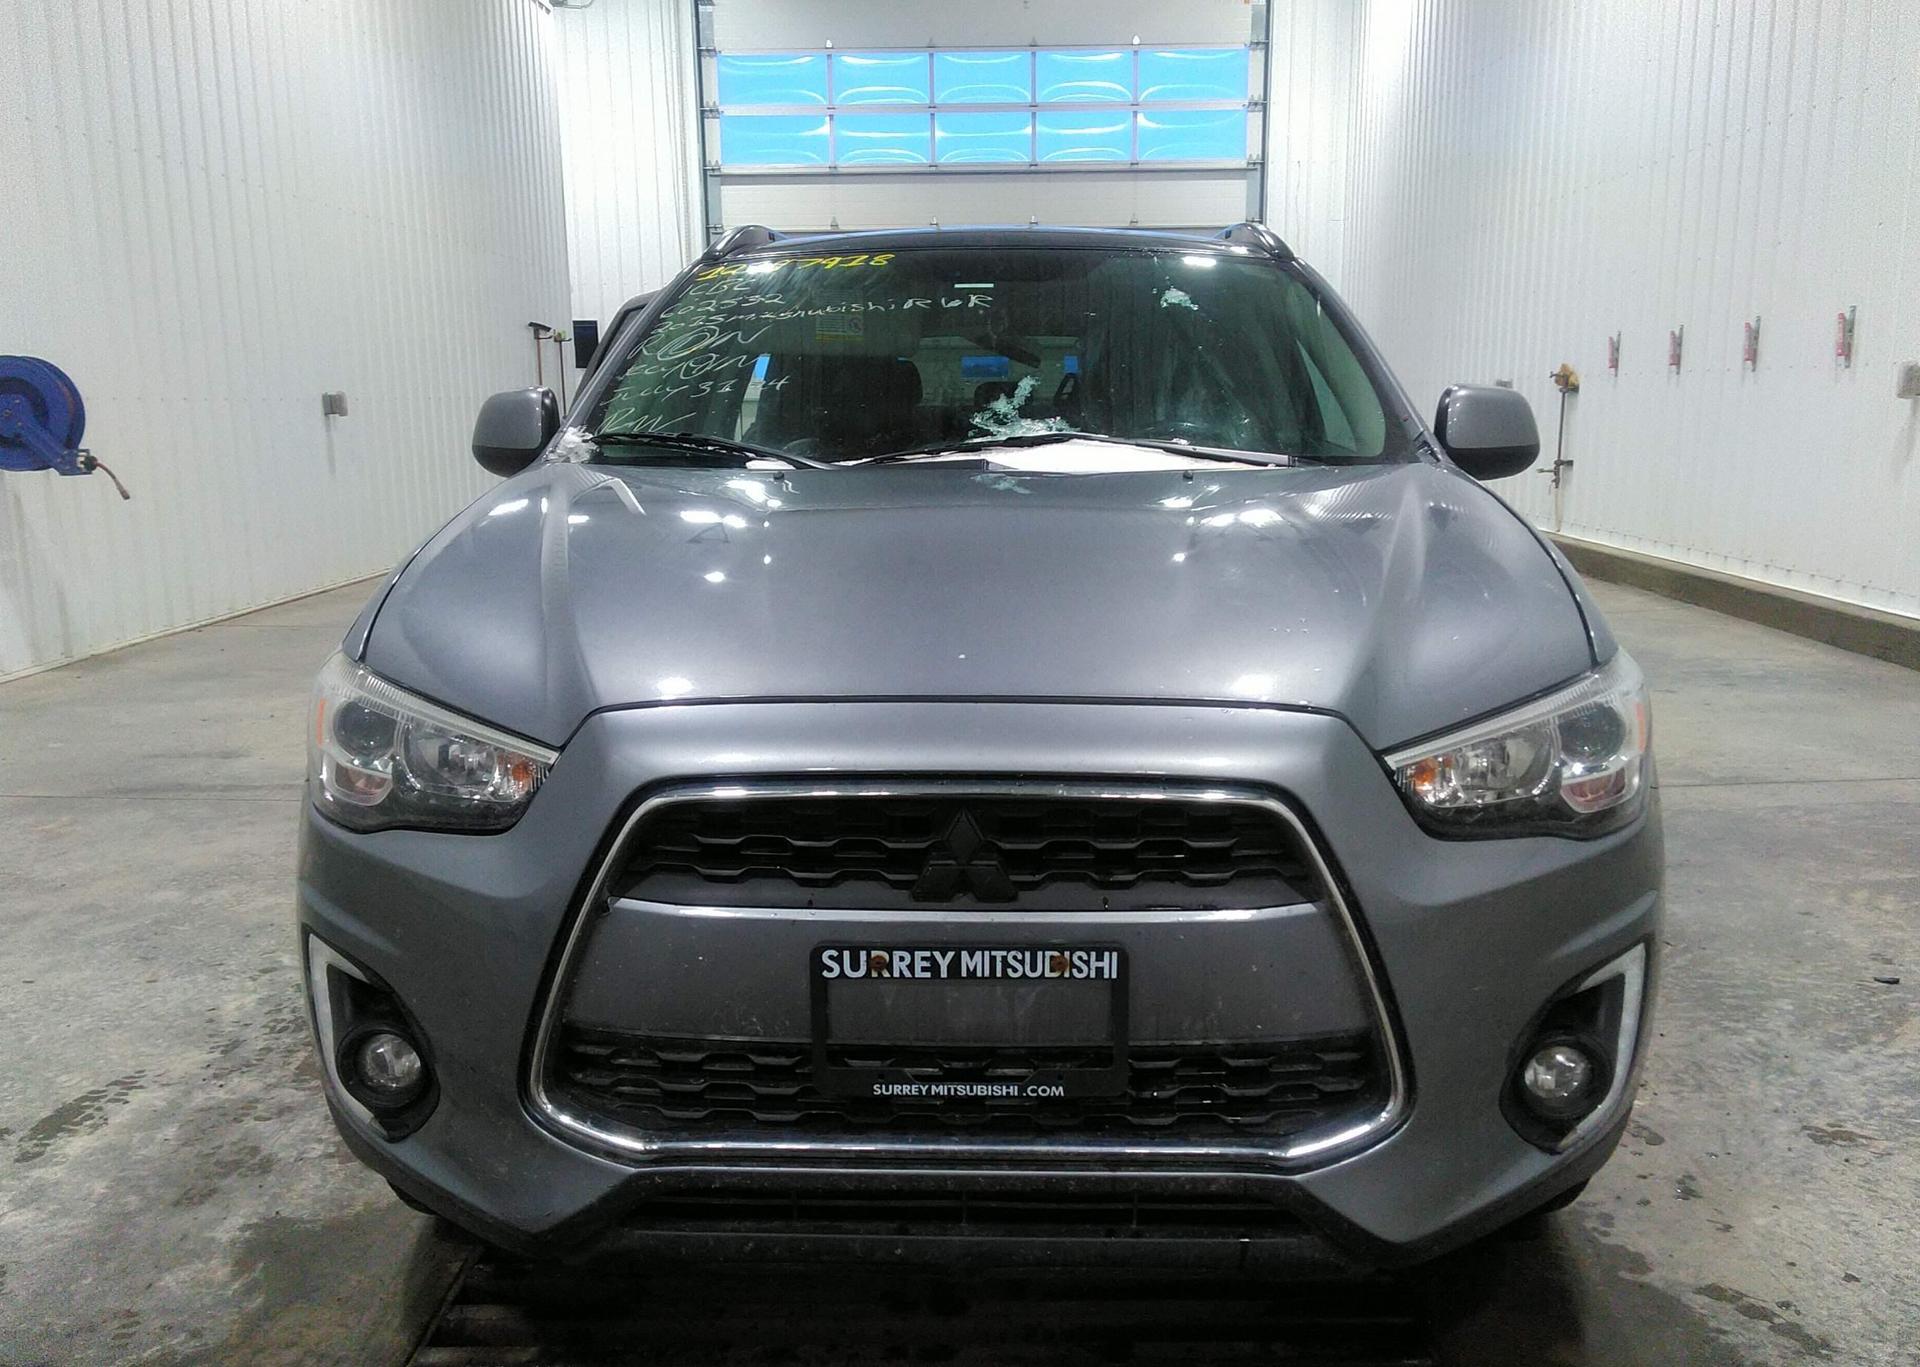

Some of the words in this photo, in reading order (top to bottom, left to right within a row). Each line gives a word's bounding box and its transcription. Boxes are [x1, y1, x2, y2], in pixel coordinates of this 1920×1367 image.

[822, 949, 955, 978] SURREY
[873, 1084, 929, 1096] SURREY
[931, 1084, 1019, 1097] MITSUBISHI
